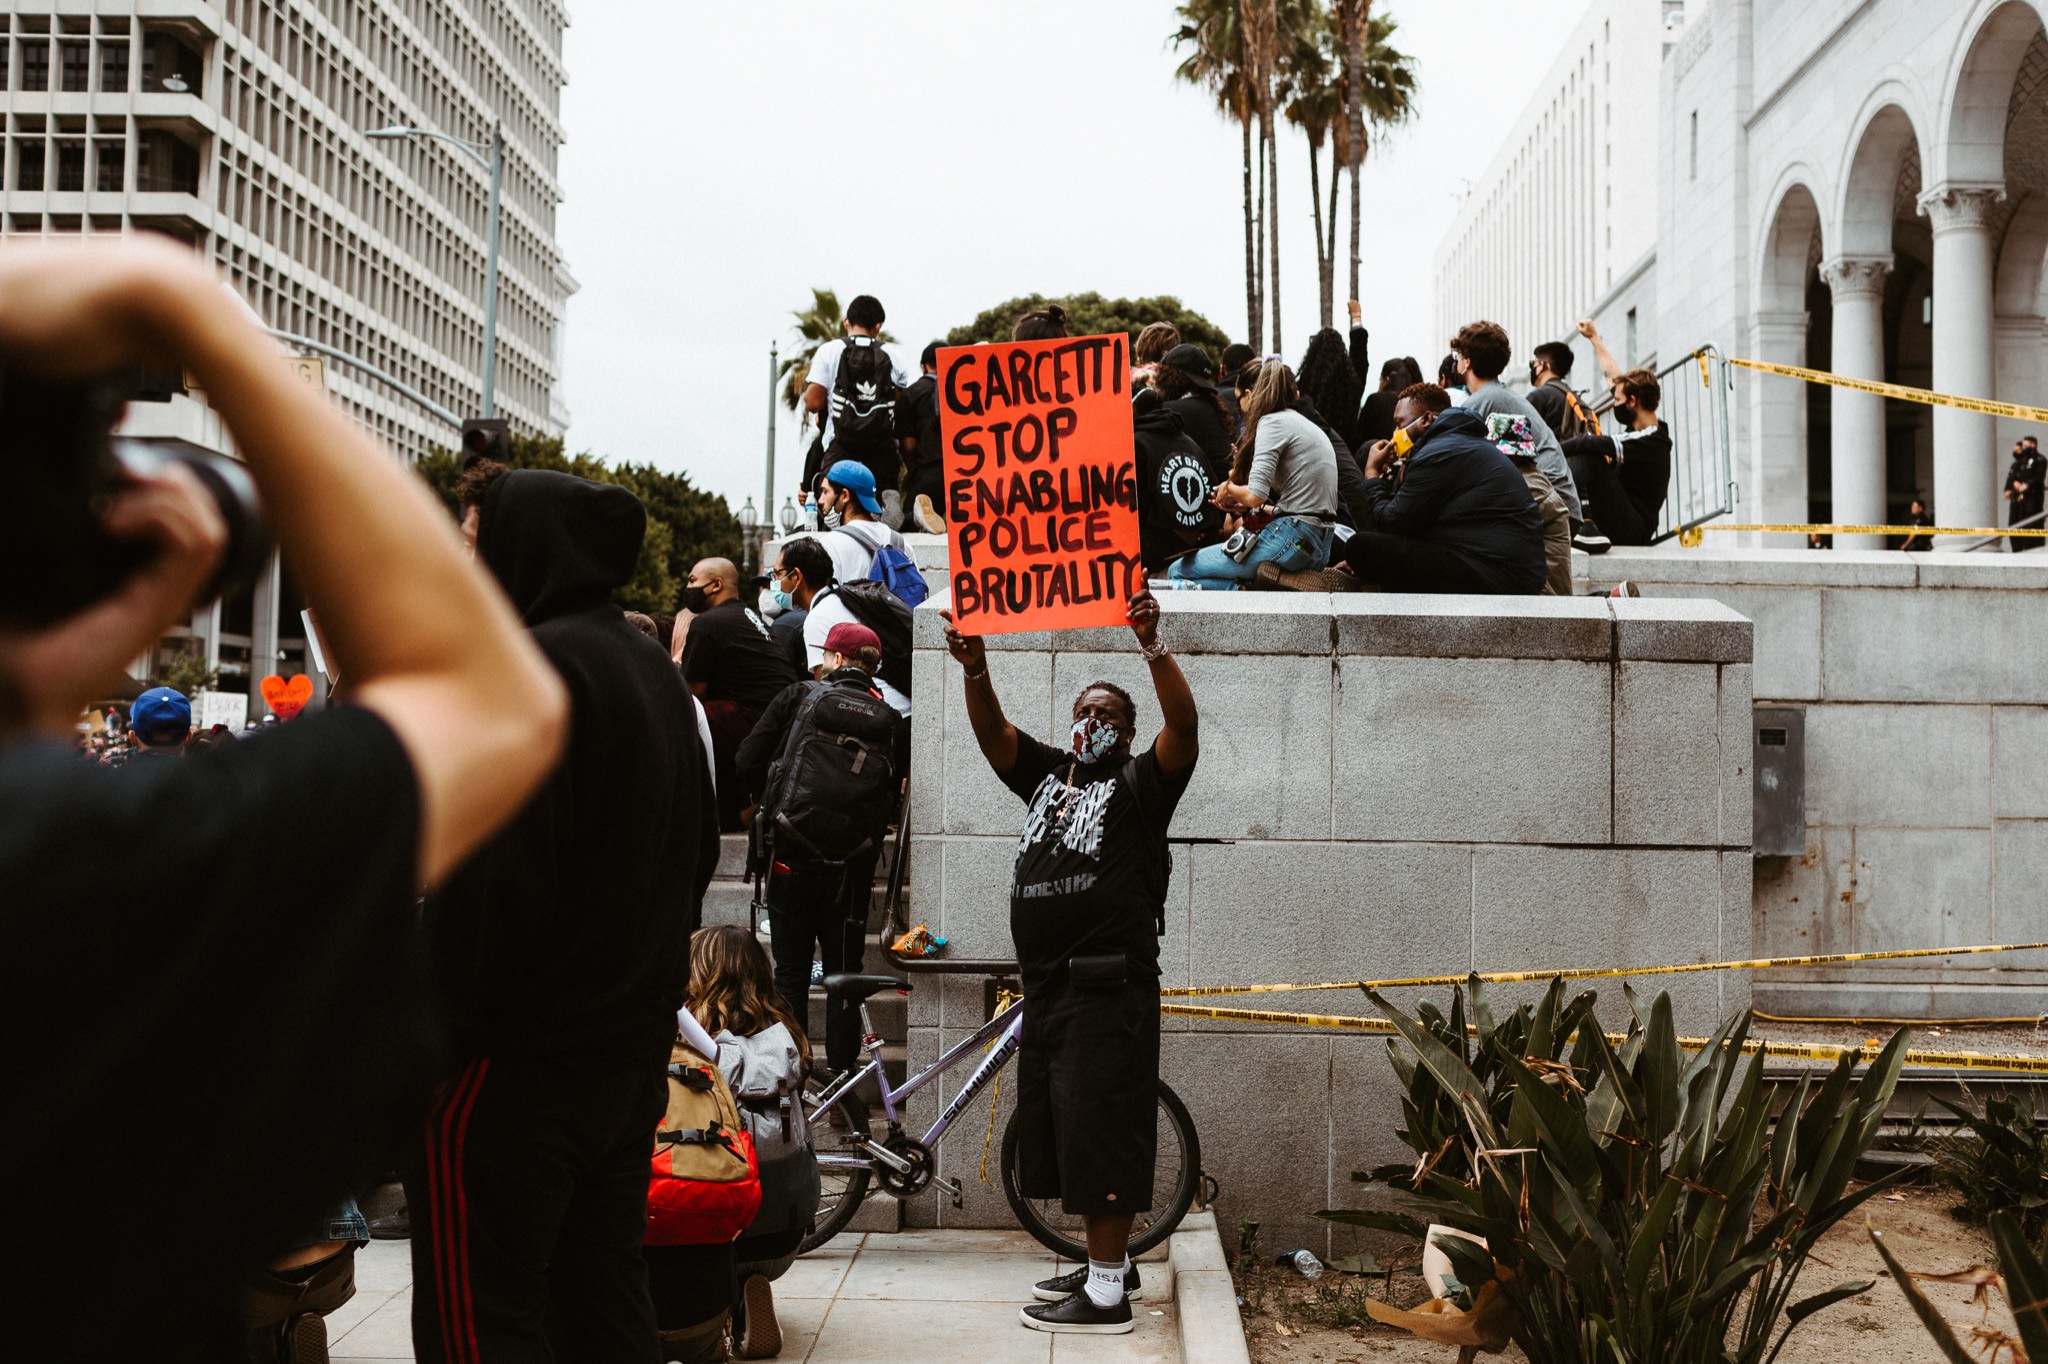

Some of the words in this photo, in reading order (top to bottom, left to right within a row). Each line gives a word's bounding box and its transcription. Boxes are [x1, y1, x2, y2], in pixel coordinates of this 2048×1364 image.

[945, 338, 1122, 416] GARCETTI
[952, 407, 1077, 476] STOP
[950, 462, 1138, 522] ENABLING
[1161, 455, 1182, 494] HEART
[1184, 456, 1210, 494] BREAK
[1176, 511, 1203, 526] GANG
[958, 511, 1112, 567] POLICE
[954, 552, 1141, 620] BRUTALITY
[838, 703, 875, 716] DAKINE
[1922, 1057, 1968, 1066] Departamento
[1972, 1059, 2010, 1068] Department
[2011, 1061, 2032, 1070] Police
